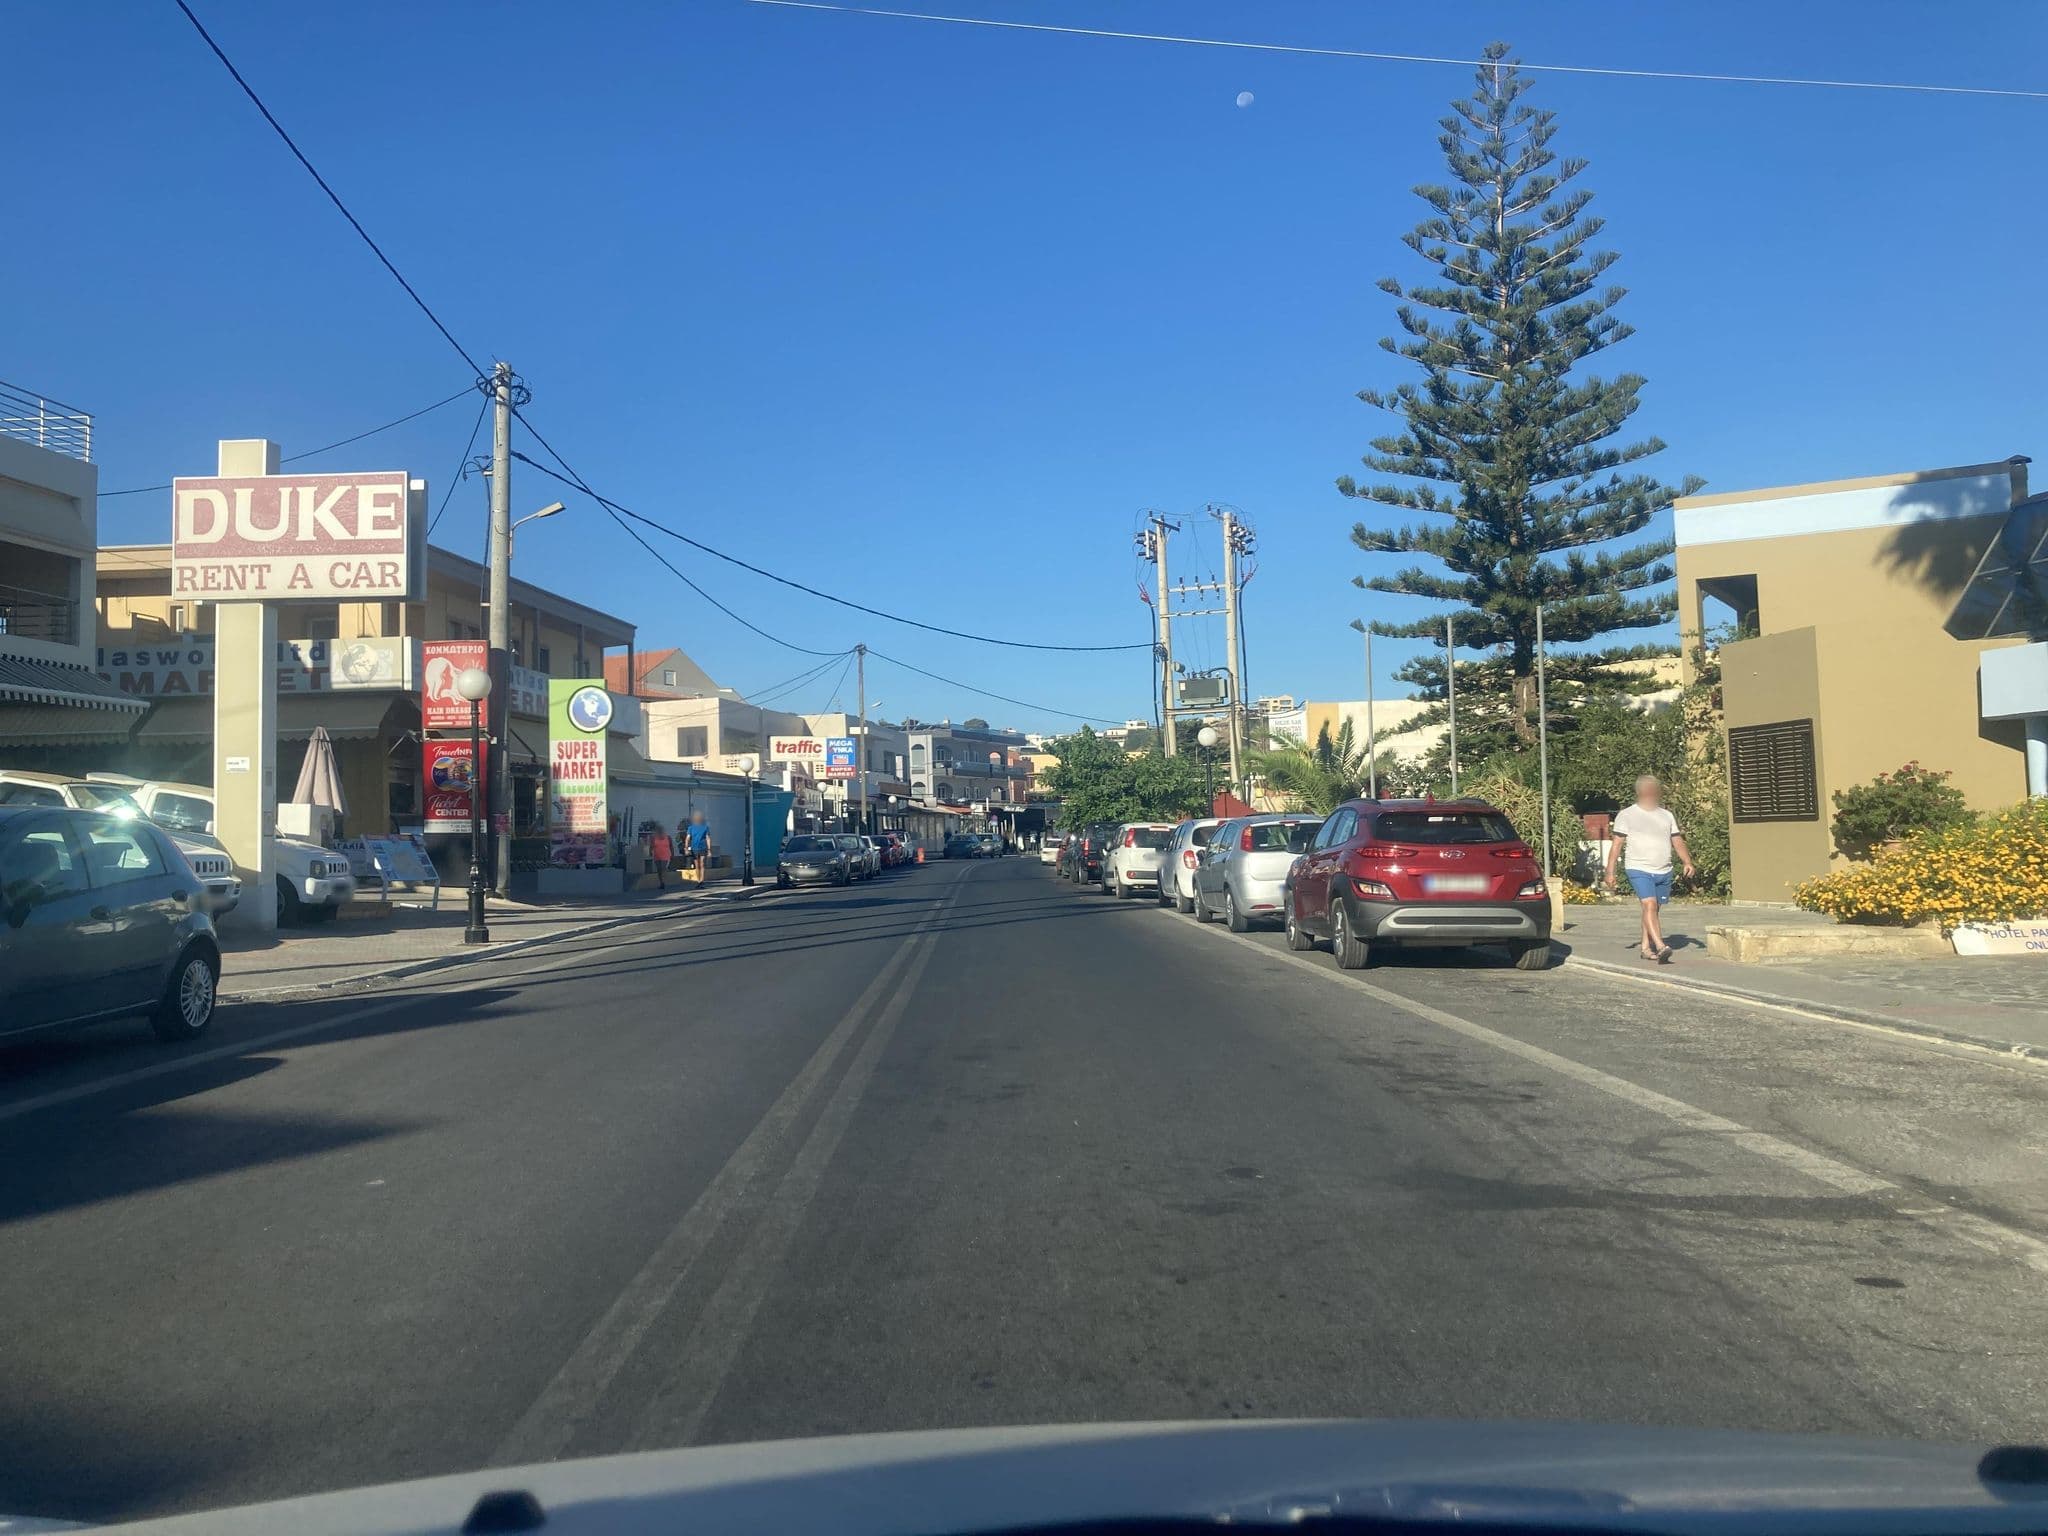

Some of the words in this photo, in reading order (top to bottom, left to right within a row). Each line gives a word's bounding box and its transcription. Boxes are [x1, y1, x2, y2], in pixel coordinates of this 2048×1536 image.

[176, 484, 403, 544] DUKE
[176, 564, 272, 592] RENT
[287, 562, 313, 589] A
[329, 561, 402, 588] CAR
[557, 741, 597, 759] SUPER
[776, 740, 822, 754] traffic
[552, 761, 603, 779] MARKET
[1991, 929, 2029, 938] HOTEL
[2031, 928, 2048, 936] PA
